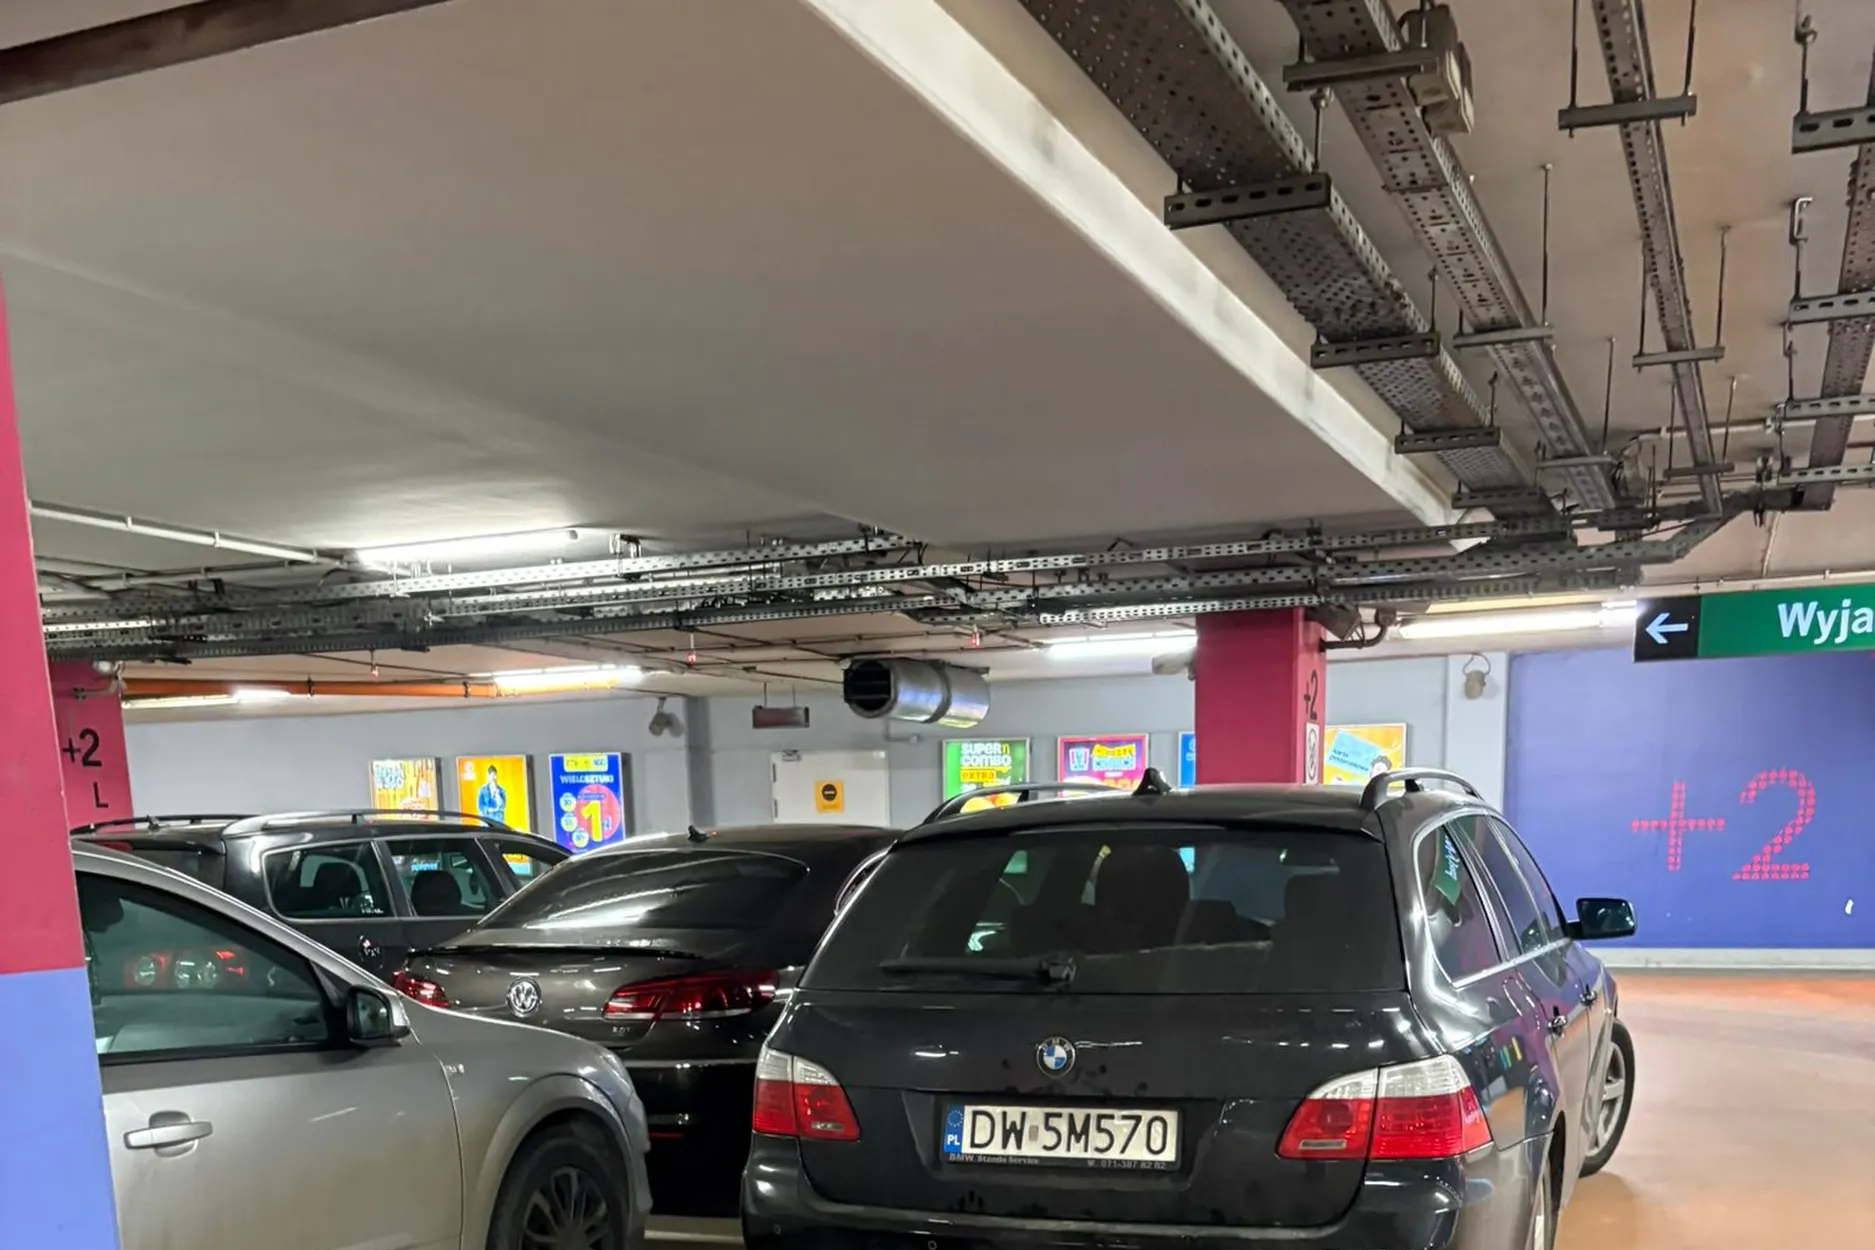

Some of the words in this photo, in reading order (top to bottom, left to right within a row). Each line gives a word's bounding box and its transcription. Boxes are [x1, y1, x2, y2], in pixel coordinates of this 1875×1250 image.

[1777, 598, 1874, 645] Wyja
[62, 728, 102, 767] +2
[962, 743, 1001, 755] SUPER
[962, 754, 1012, 767] COMBO
[93, 781, 109, 808] L
[581, 800, 603, 842] 1
[1631, 767, 1815, 880] +2
[947, 1134, 960, 1146] PL
[970, 1110, 1027, 1150] DW
[1042, 1111, 1168, 1156] 5M570
